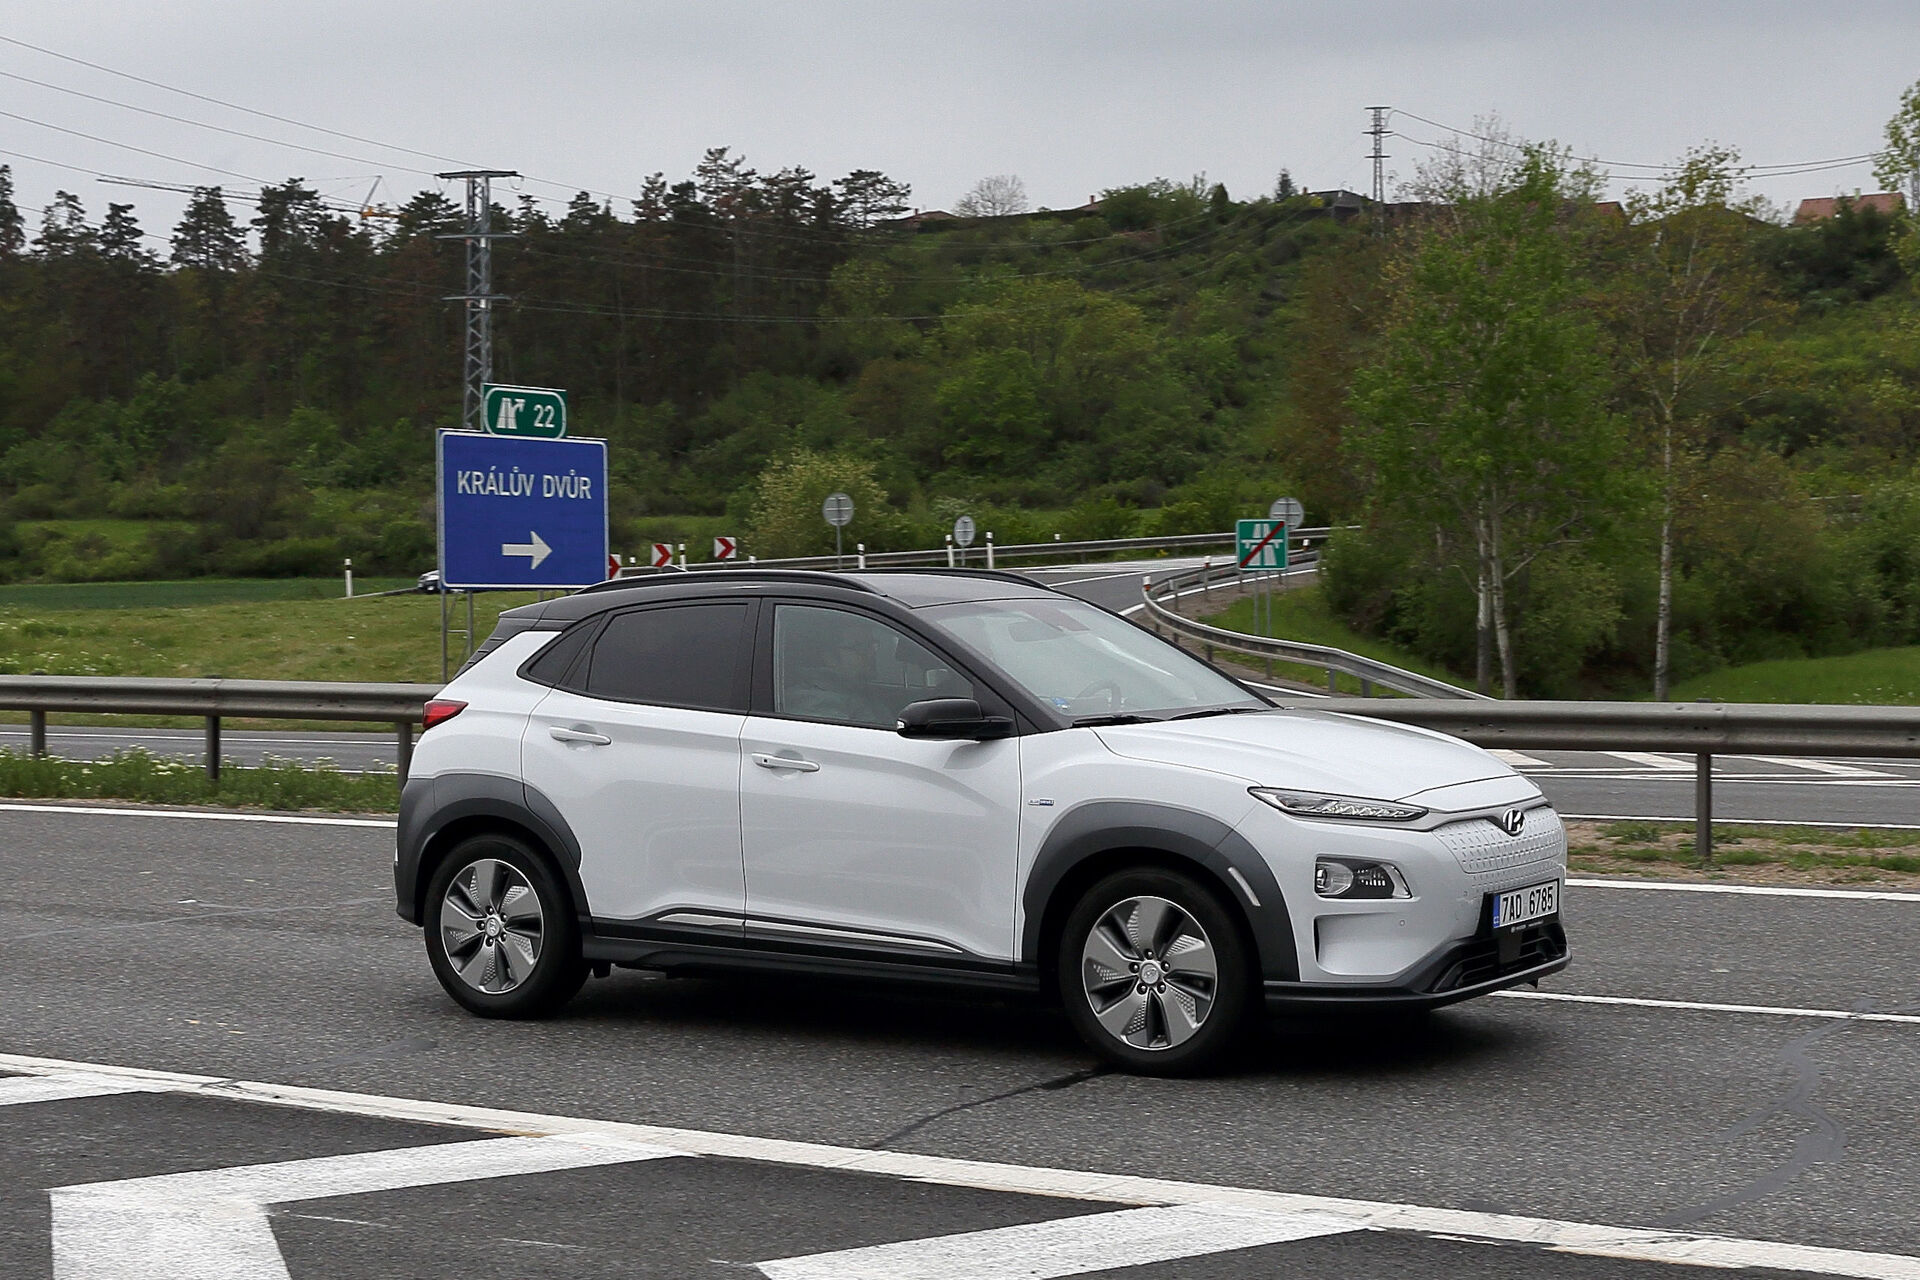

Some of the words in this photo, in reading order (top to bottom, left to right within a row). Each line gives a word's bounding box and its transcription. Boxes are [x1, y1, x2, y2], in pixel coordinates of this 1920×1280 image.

[534, 405, 555, 428] 22
[457, 466, 535, 497] KRÁLŮV
[543, 469, 592, 499] DVŮR
[1502, 895, 1522, 922] 7AD
[1529, 886, 1553, 915] 6785
